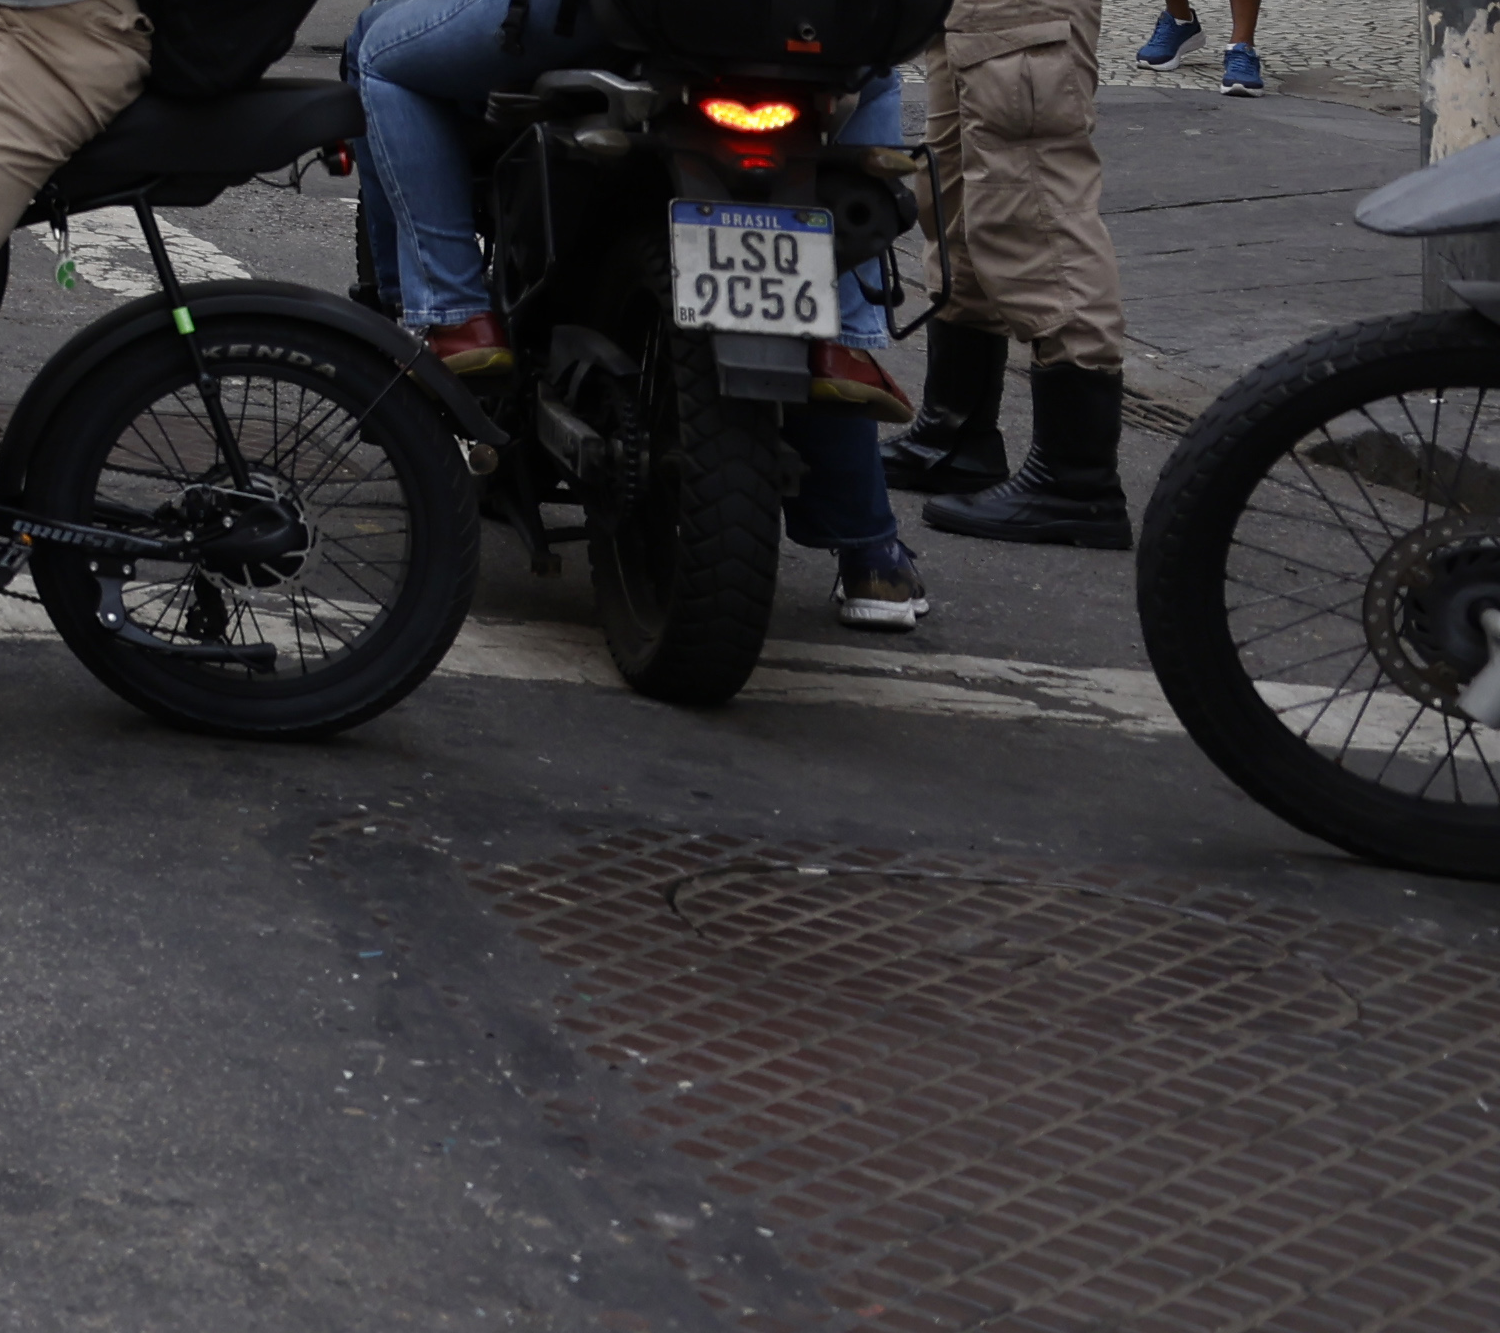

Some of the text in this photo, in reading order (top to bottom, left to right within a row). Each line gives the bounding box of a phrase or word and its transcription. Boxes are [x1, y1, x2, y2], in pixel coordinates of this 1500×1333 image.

[721, 212, 782, 229] BRASIL
[707, 228, 799, 276] LSQ
[695, 273, 818, 323] 9C56
[679, 306, 697, 323] BR
